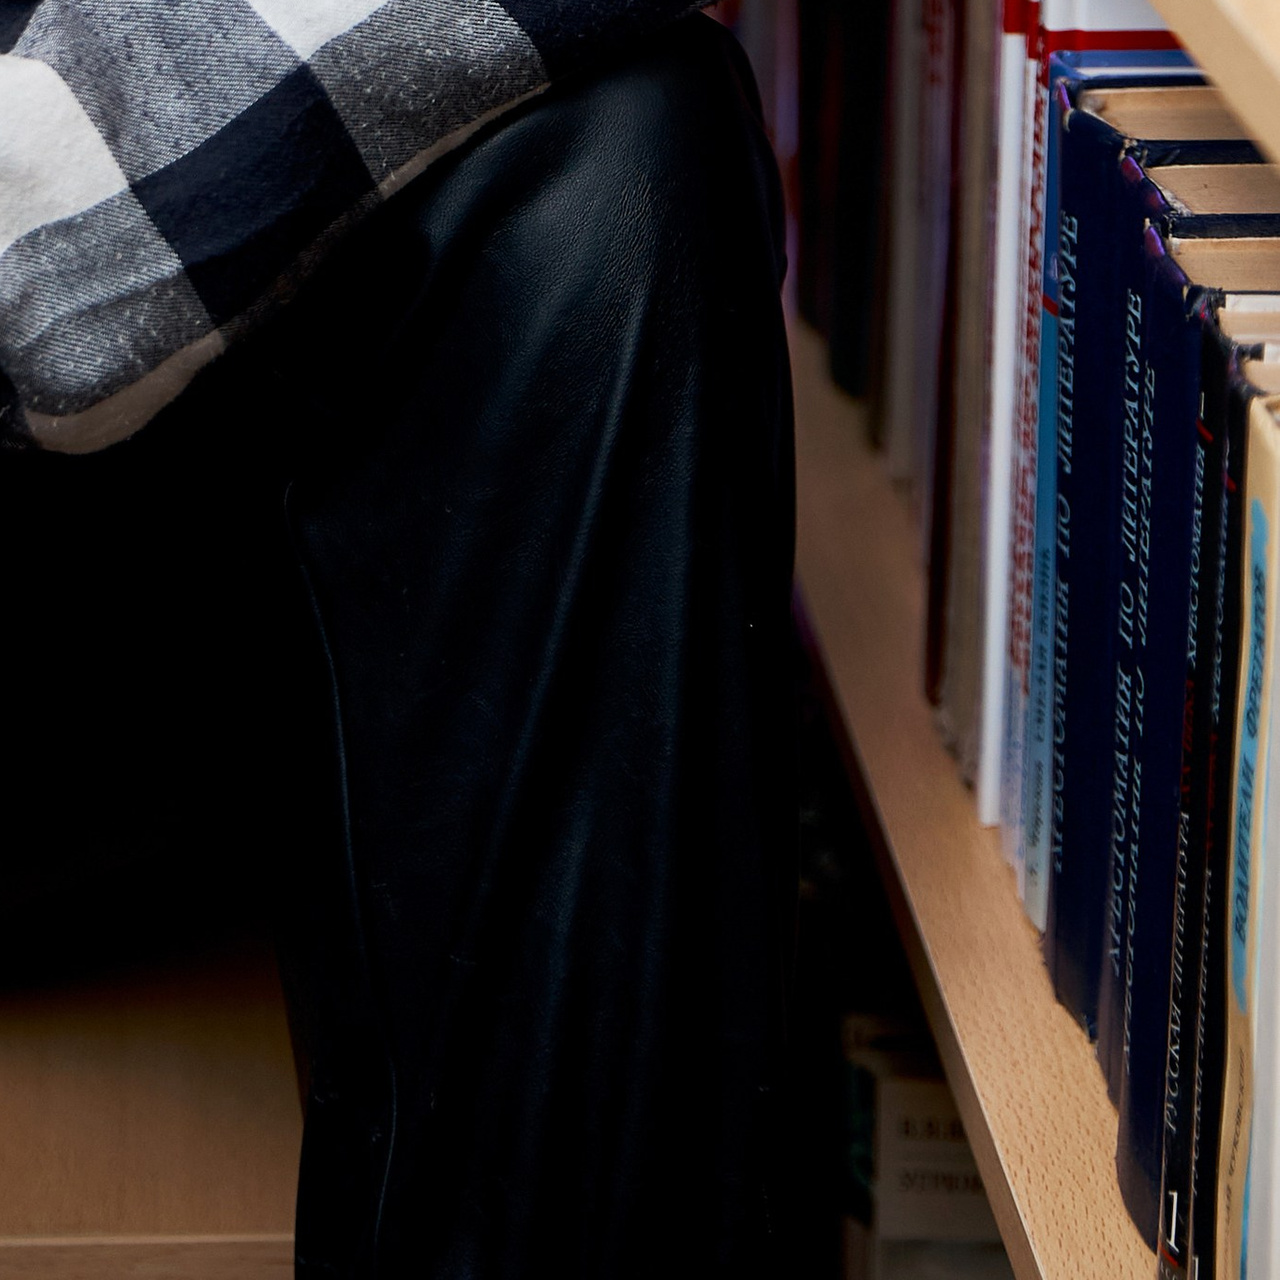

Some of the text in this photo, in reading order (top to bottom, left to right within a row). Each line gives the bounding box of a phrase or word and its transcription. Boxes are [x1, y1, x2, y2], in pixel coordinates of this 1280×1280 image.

[1057, 209, 1078, 475] ЛИТЕРАТУРЕ
[1137, 359, 1156, 647] ЛИТЕРАТУРЕ
[1185, 440, 1206, 671] ХРЕСТОМАТИЯ
[1107, 287, 1142, 979] ХРЕСТОМАТИЯ ПО ЛИТЕРАТУРЕ
[1172, 809, 1191, 1000] ЛИТЕРАТУРА
[1234, 754, 1256, 946] ВОДИТЕЛИ
[1163, 1000, 1182, 1137] РУССКАЯ
